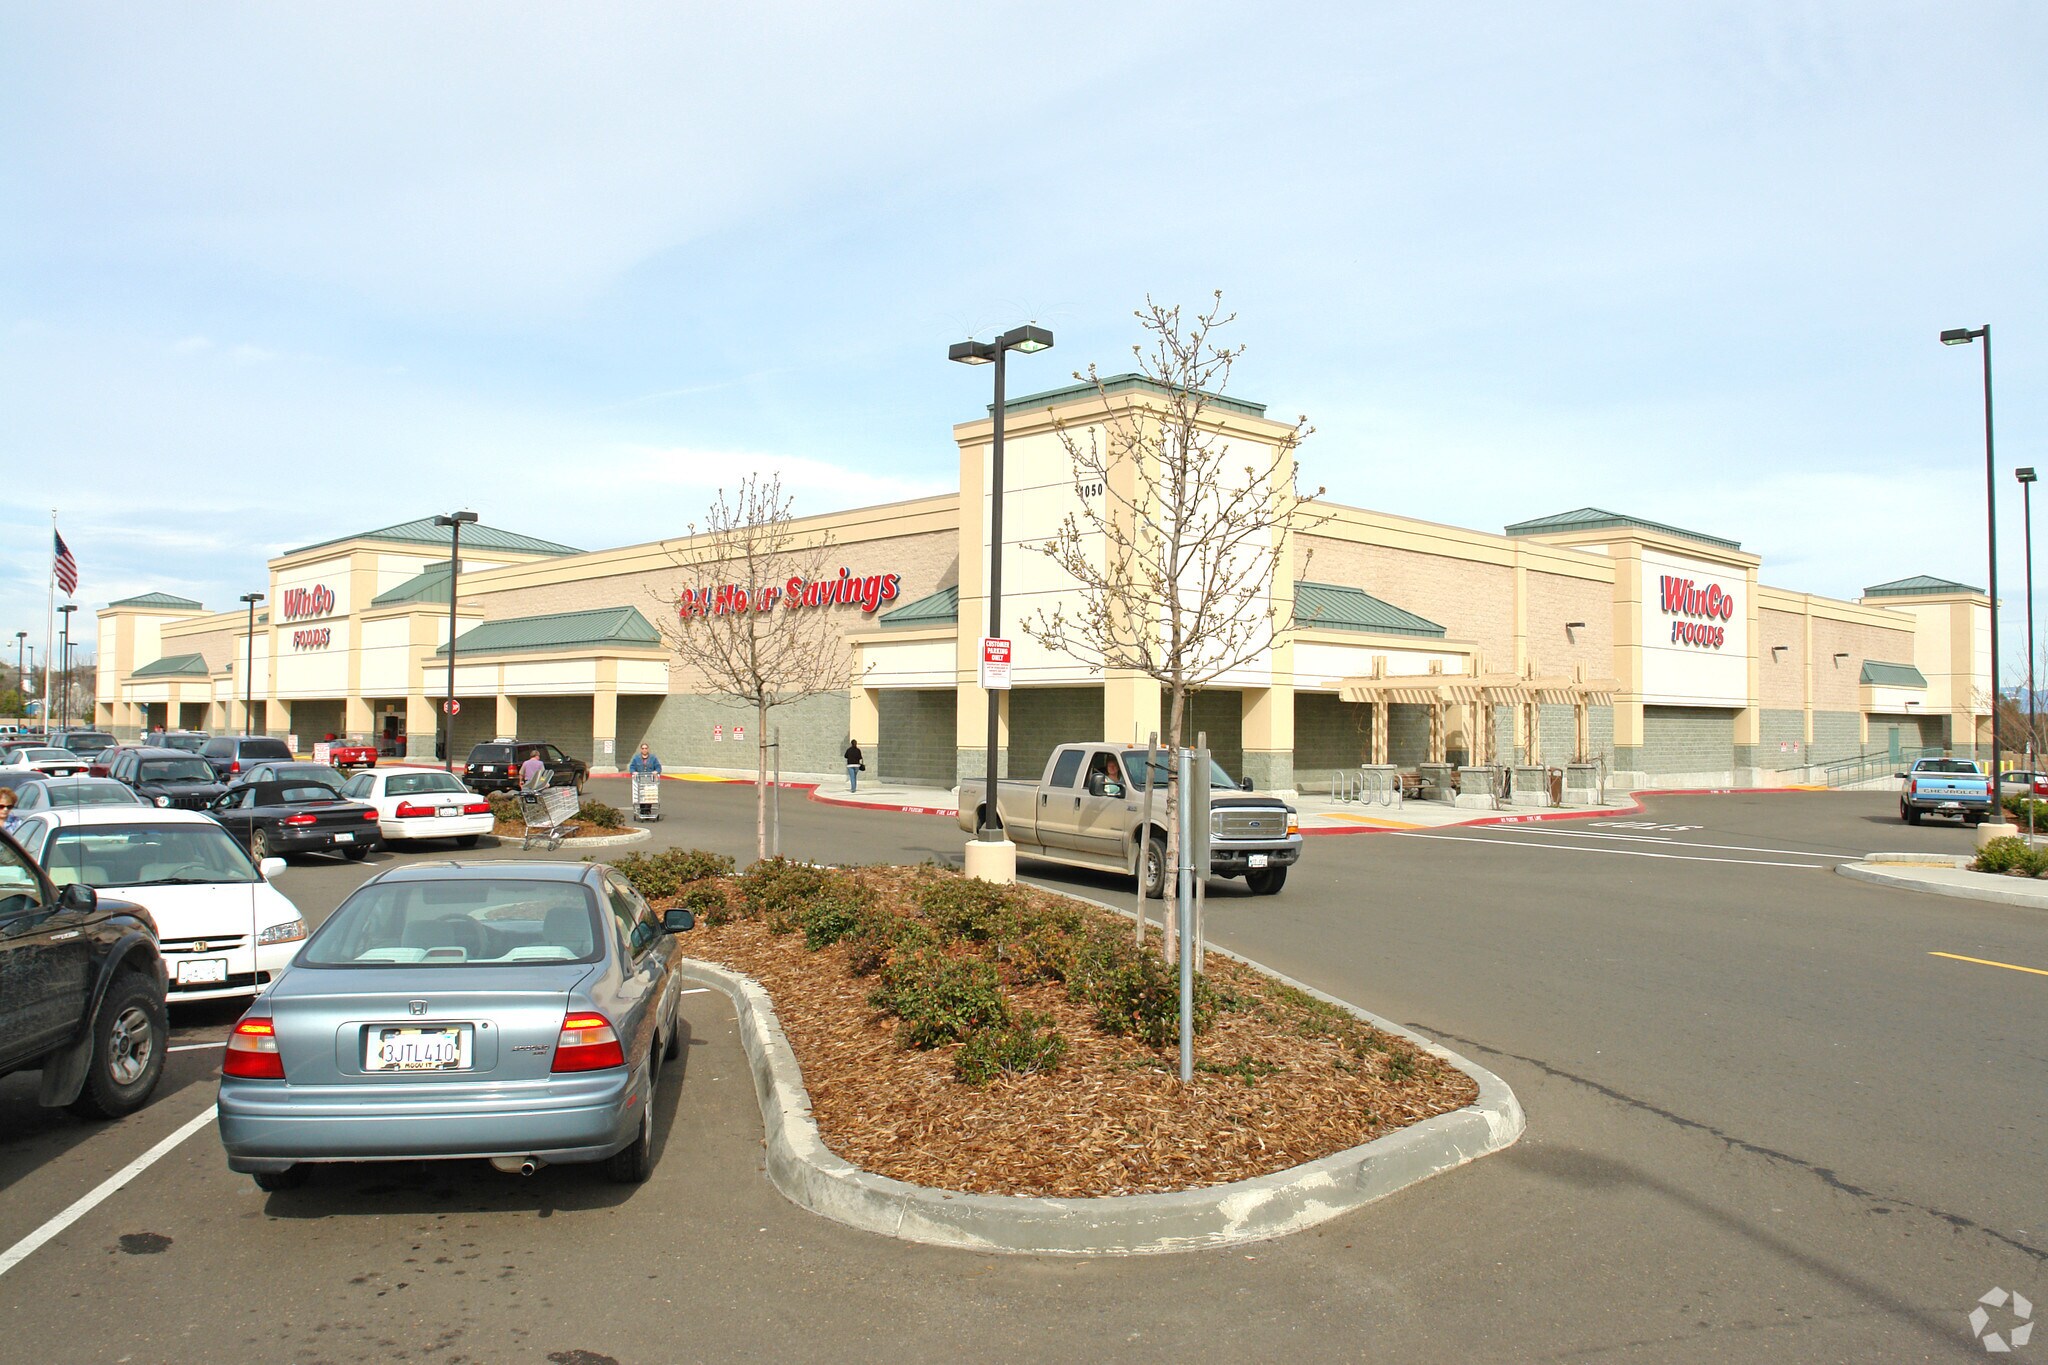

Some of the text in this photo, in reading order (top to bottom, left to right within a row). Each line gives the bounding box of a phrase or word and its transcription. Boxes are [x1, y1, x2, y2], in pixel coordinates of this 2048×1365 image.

[284, 584, 335, 619] WinCo
[680, 587, 711, 617] 24
[785, 566, 900, 614] Savings
[1660, 575, 1734, 620] WinCo
[293, 627, 331, 650] FOODS
[986, 640, 1010, 648] CUSTOMER
[1671, 621, 1725, 648] FOODS
[987, 647, 1009, 655] PARKING
[385, 1044, 454, 1062] 3JTL410
